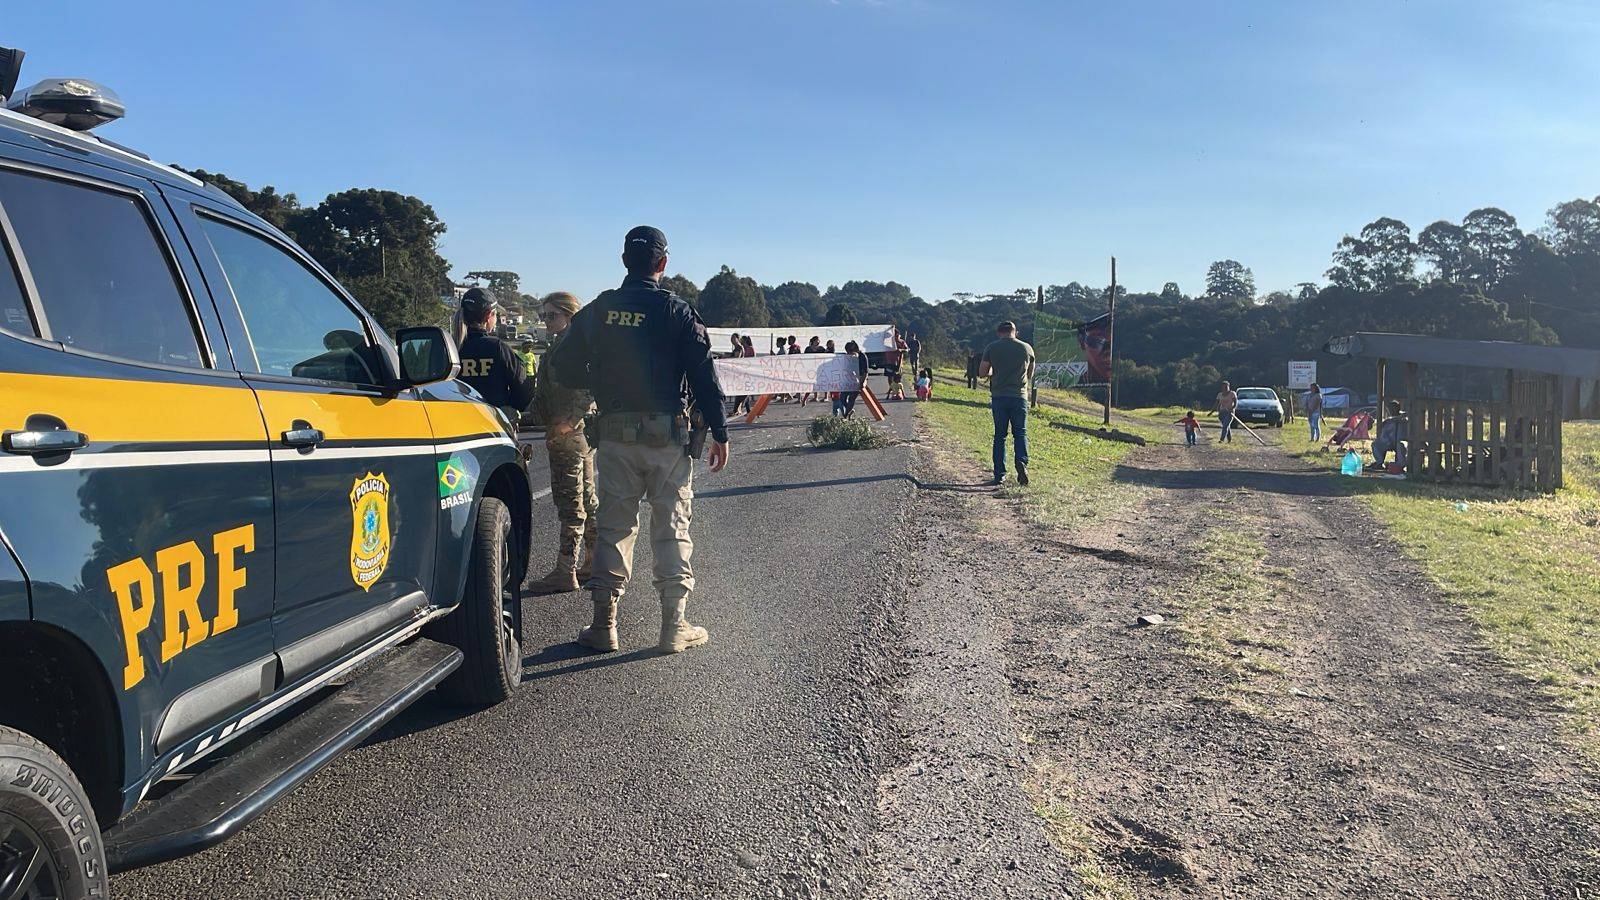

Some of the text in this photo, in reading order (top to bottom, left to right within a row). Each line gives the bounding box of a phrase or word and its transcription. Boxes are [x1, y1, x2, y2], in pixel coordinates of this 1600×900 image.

[605, 310, 646, 326] PRF
[461, 358, 493, 377] RF
[440, 492, 473, 510] BRASIL
[360, 565, 381, 582] FEDERAL
[106, 524, 255, 691] PRF
